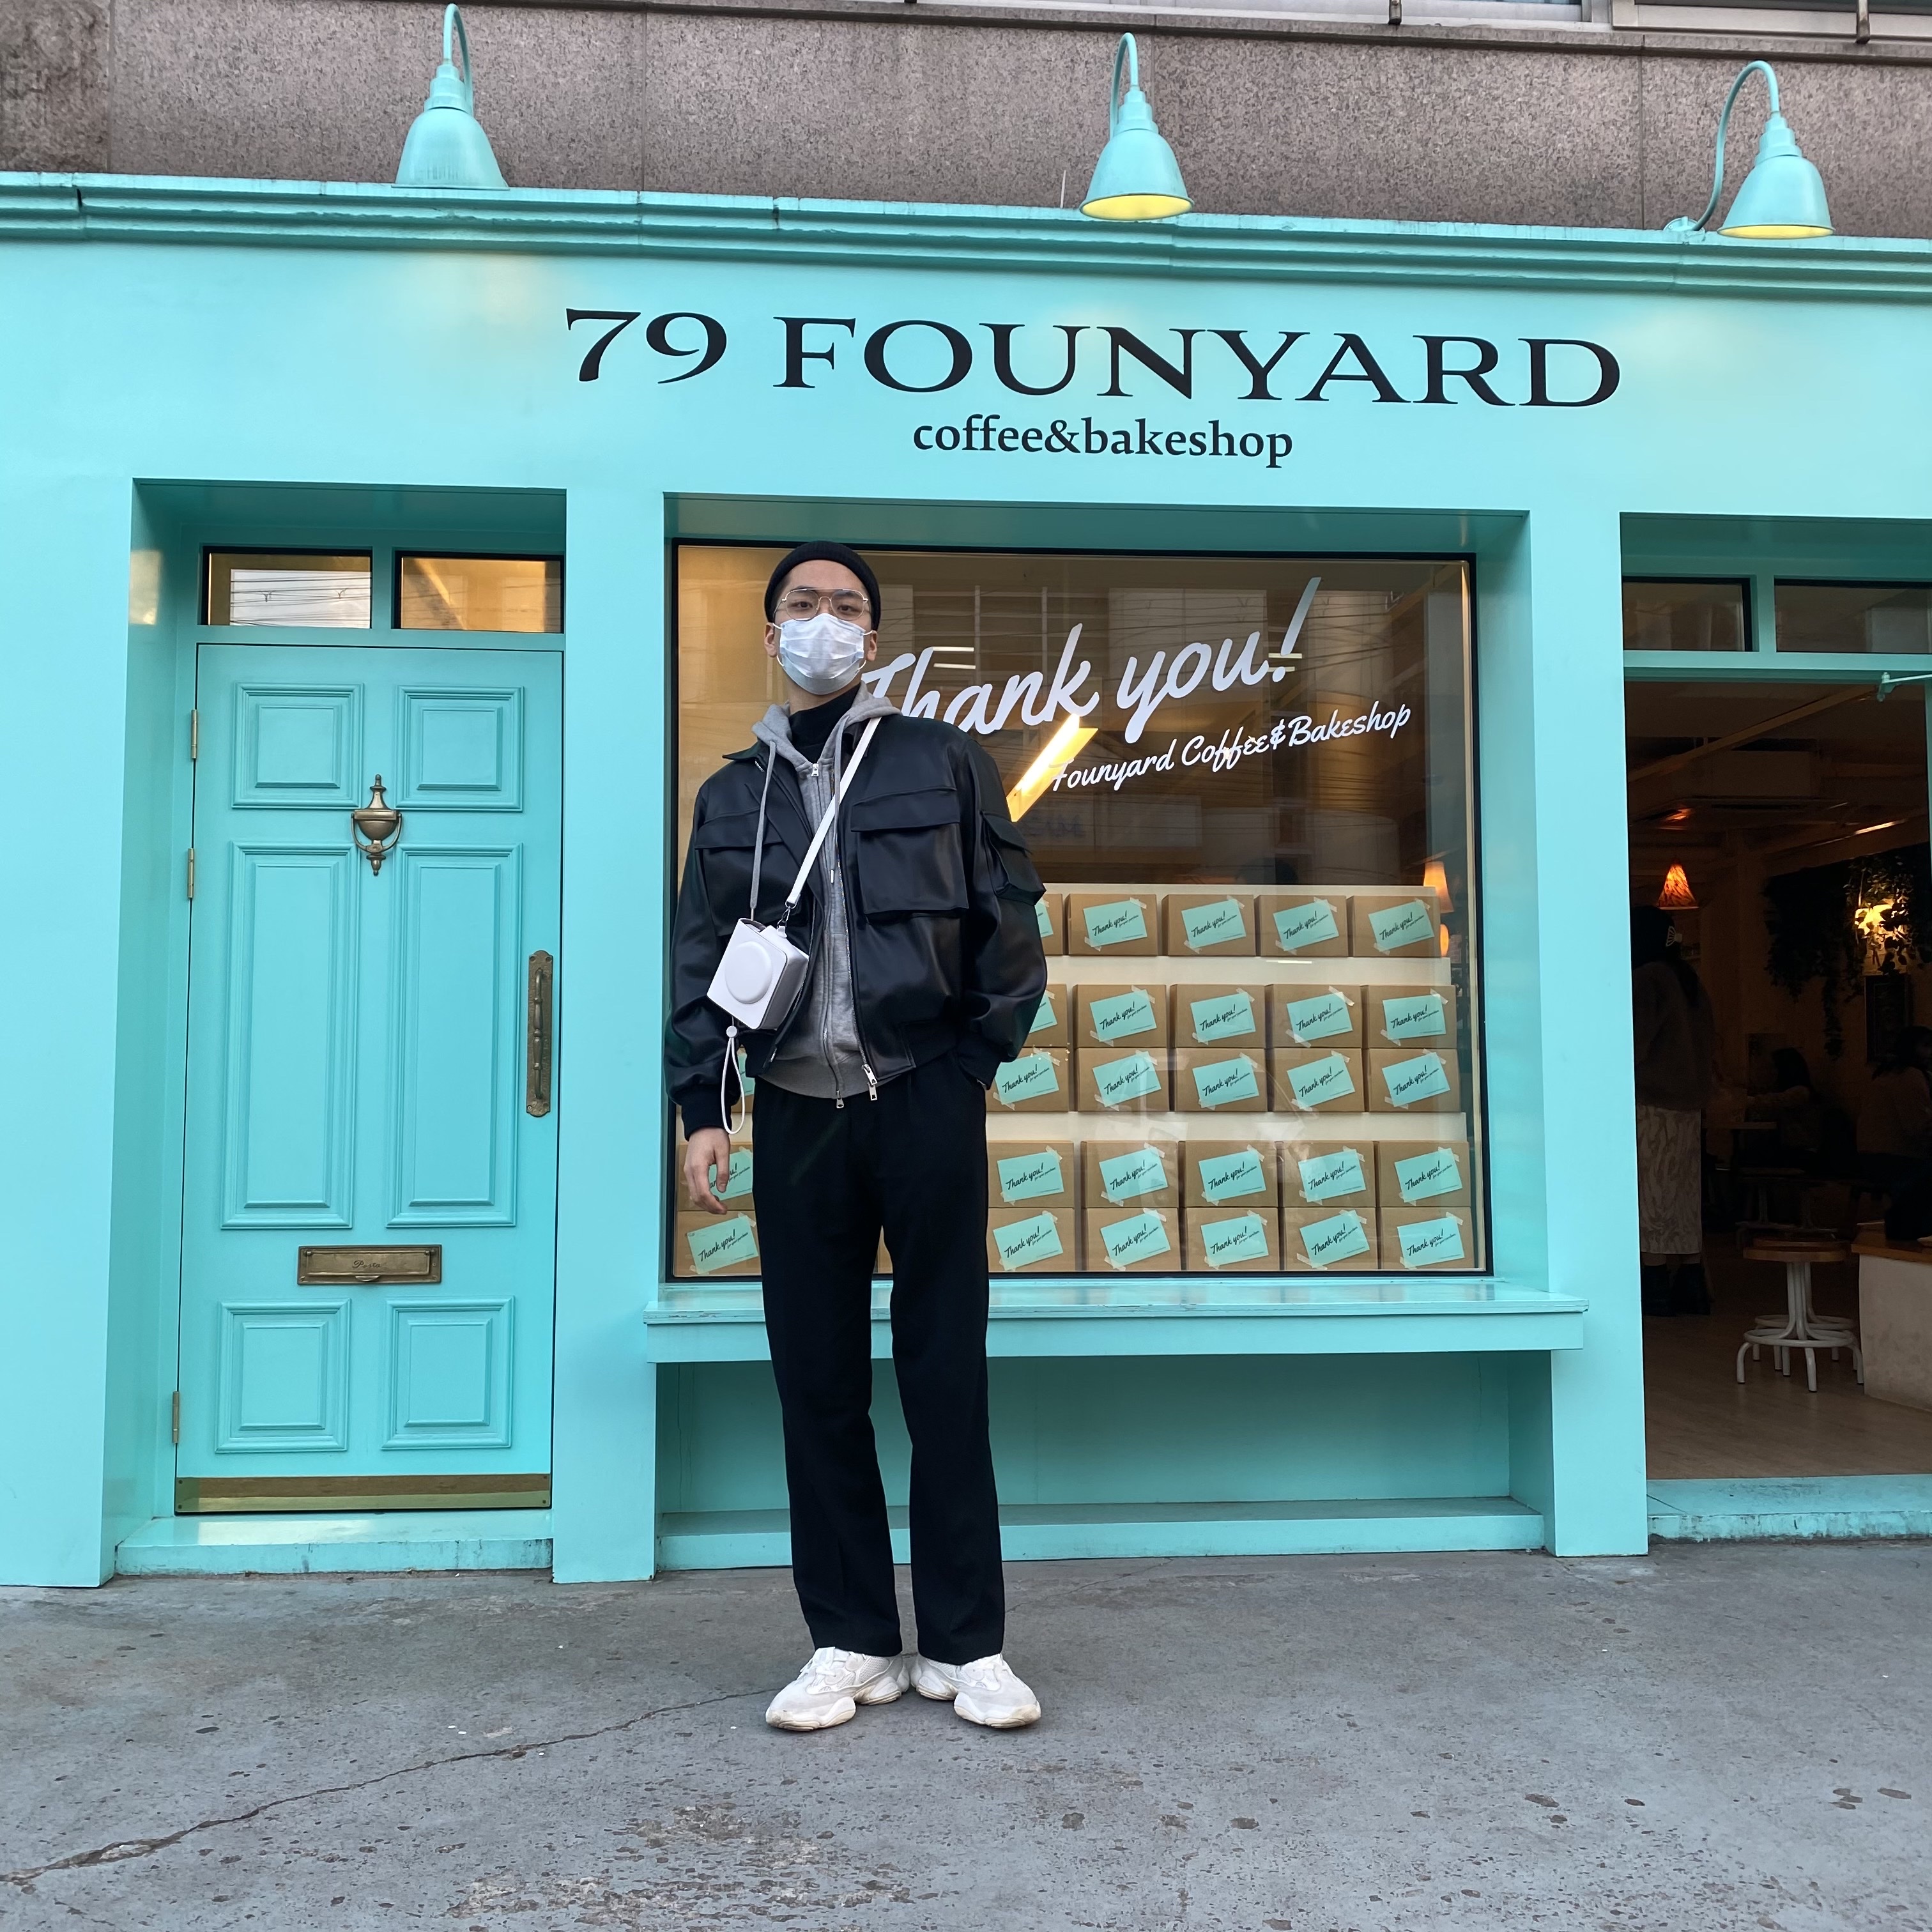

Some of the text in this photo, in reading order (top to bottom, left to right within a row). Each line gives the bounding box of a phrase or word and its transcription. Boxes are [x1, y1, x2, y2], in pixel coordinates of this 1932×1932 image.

[566, 309, 1620, 406] 79 FOUNYARD
[914, 414, 1292, 468] coffee&bakeshop
[1116, 576, 1322, 744] you!
[1092, 910, 1127, 936] Thank you!
[1191, 911, 1225, 938] Thank you!
[1284, 922, 1305, 940] Thank
[1305, 911, 1317, 930] you!
[1379, 923, 1400, 940] Thank
[1400, 912, 1413, 930] you!
[1100, 1001, 1135, 1030] Thank you!
[1200, 1004, 1236, 1031] Thank you!
[1296, 1004, 1331, 1031] Thank you!
[1391, 1005, 1427, 1029] Thank you!
[1002, 1075, 1023, 1093] Thank
[1024, 1064, 1038, 1083] you!
[1104, 1076, 1125, 1095] Thank
[1125, 1064, 1138, 1084] you!
[1202, 1068, 1238, 1096] Thank you!
[1299, 1078, 1320, 1098] Thank
[1320, 1067, 1332, 1086] you!
[1393, 1077, 1414, 1096] Thank
[1414, 1065, 1427, 1084] you!
[1006, 1163, 1043, 1190] Thank you!
[1110, 1160, 1146, 1191] Thank you!
[1208, 1162, 1245, 1190] Thank you!
[1308, 1161, 1344, 1190] Thank you!
[1405, 1172, 1427, 1190] Thank
[1427, 1161, 1440, 1180] you!
[698, 1242, 721, 1262] Thank
[721, 1229, 735, 1250] you!
[1004, 1239, 1026, 1258] Thank
[1027, 1226, 1039, 1246] you!
[1112, 1236, 1134, 1257] Thank
[1134, 1223, 1147, 1245] you!
[1211, 1226, 1247, 1255] Thank you!
[1312, 1236, 1333, 1255] Thank
[1333, 1223, 1346, 1244] you!
[1407, 1229, 1443, 1257] Thank you!
[352, 1260, 381, 1269] Posta
